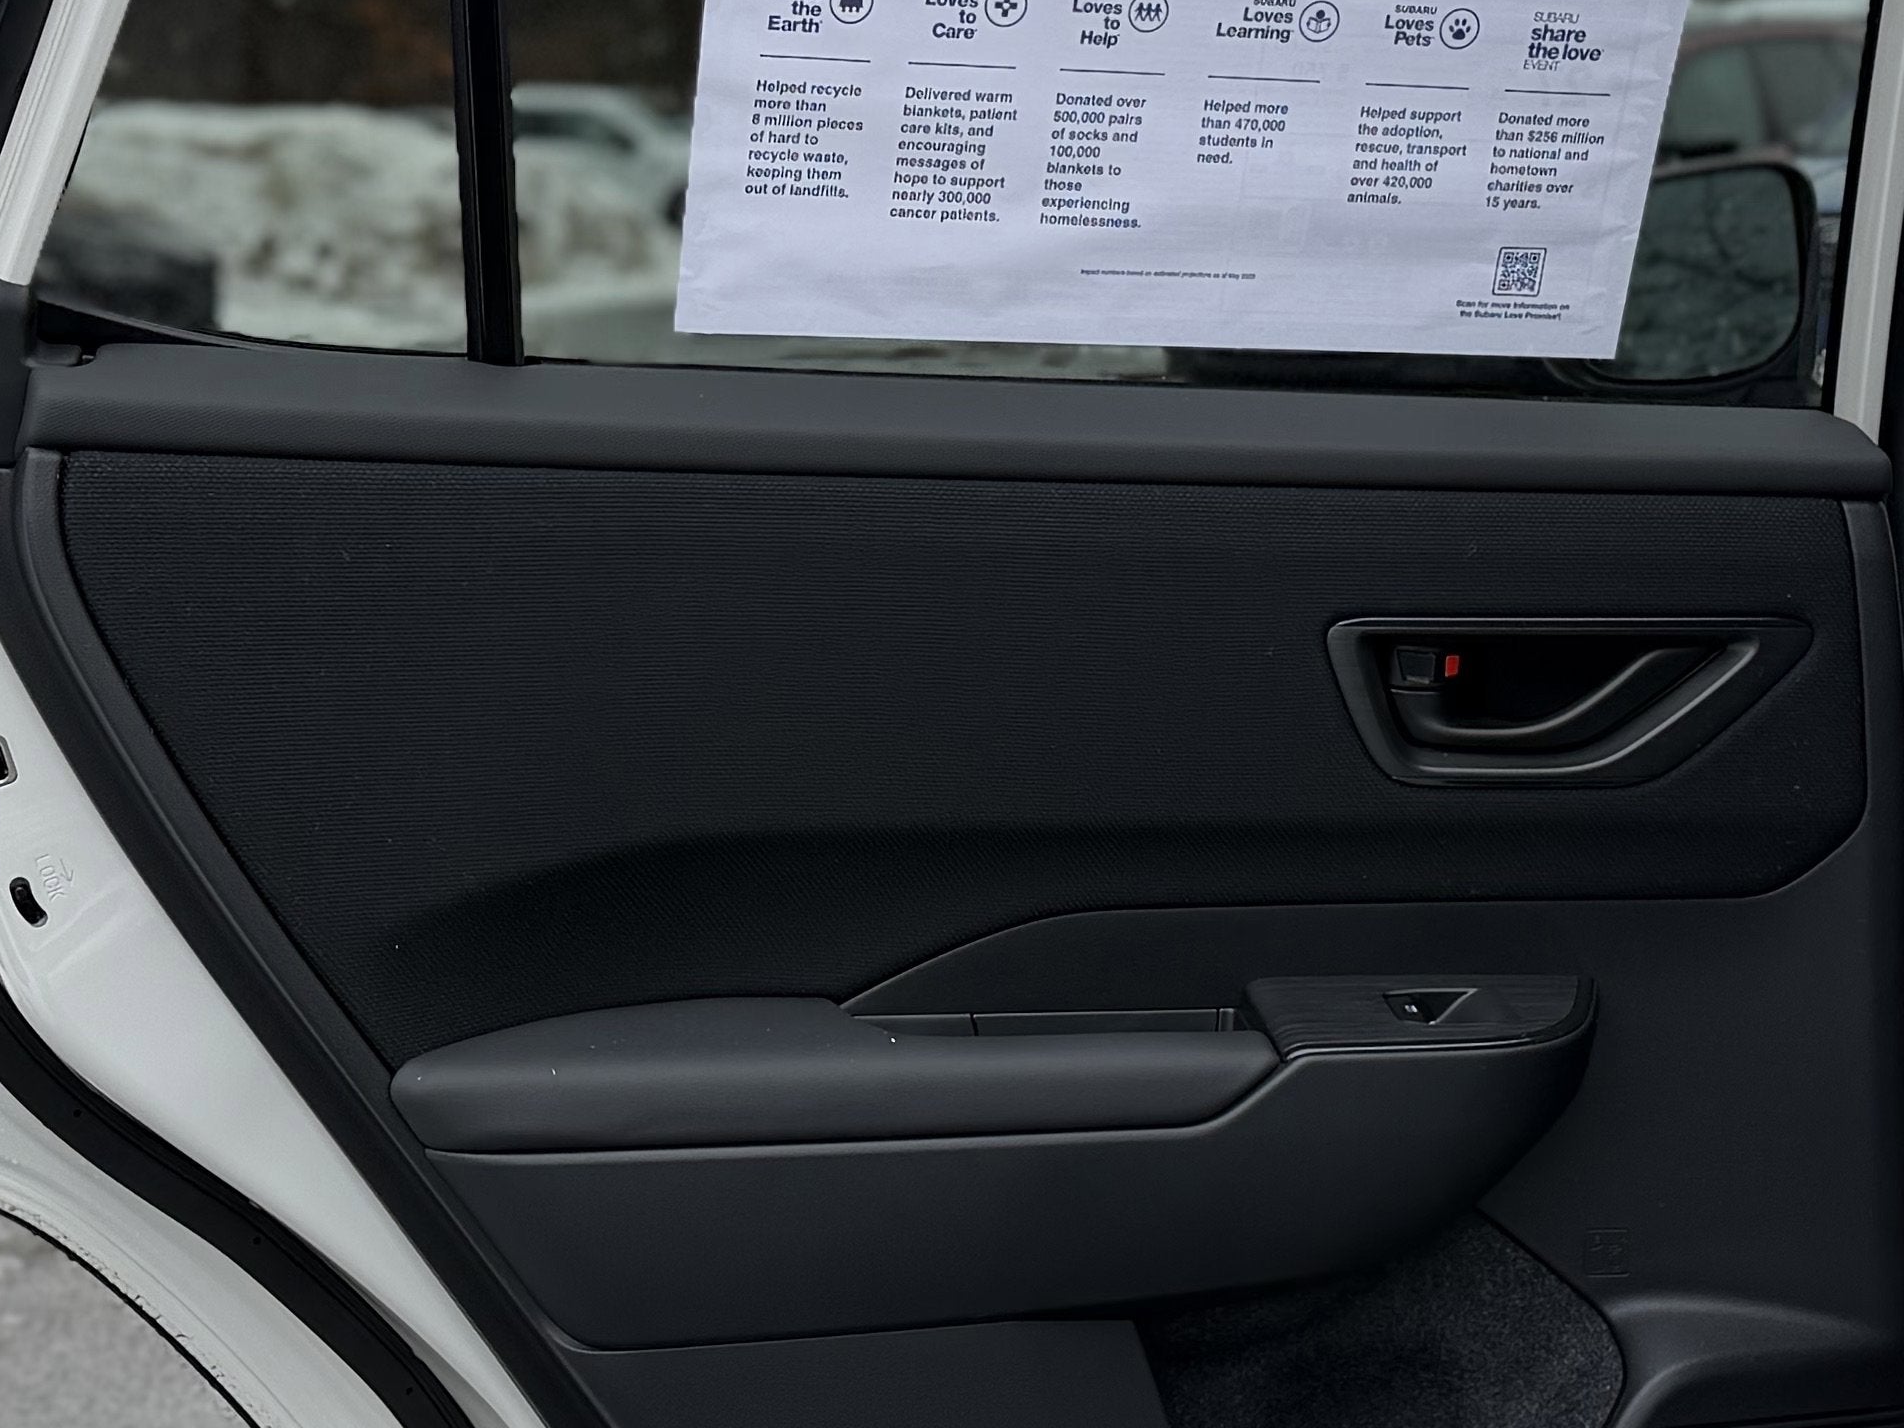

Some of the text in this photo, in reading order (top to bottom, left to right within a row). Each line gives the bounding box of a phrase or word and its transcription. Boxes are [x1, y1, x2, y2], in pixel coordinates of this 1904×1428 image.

[791, 0, 821, 17] the
[958, 9, 977, 25] to
[1242, 6, 1294, 24] Loves
[1394, 4, 1438, 16] SUBARU
[767, 15, 819, 34] Earth
[1103, 15, 1121, 31] to
[1384, 14, 1435, 32] Loves
[1533, 11, 1580, 25] SUBARU
[932, 22, 978, 40] Care
[1079, 29, 1121, 49] Help
[1215, 22, 1292, 44] Learning
[1393, 30, 1435, 47] Pets
[1530, 23, 1587, 44] share
[1528, 41, 1602, 62] the love
[1522, 58, 1561, 72] EVENT
[756, 79, 862, 99] Helped recycle
[905, 86, 1013, 104] Delivered warm
[753, 98, 827, 112] more than
[1055, 92, 1147, 109] Donated over
[1203, 99, 1289, 116] Helped more
[902, 103, 1018, 122] blankets, patient
[1053, 110, 1143, 127] 500,000 pairs
[1360, 105, 1462, 125] Helped support
[1498, 111, 1590, 128] Donated more
[751, 113, 864, 132] 8 million pieces
[900, 121, 994, 139] care kits, and
[1201, 116, 1286, 133] than 470,000
[749, 129, 819, 146] of hard to
[1051, 127, 1139, 143] of socks and
[1358, 122, 1443, 141] the adoption,
[1495, 128, 1605, 145] than $256 million
[897, 140, 986, 157] encouraging
[1198, 134, 1274, 149] students in
[1355, 142, 1467, 158] rescue, transport
[748, 148, 848, 166] recycle waste,
[1049, 144, 1101, 161] 100,000
[1196, 151, 1233, 164] need.
[1492, 146, 1590, 161] to national and
[895, 156, 986, 172] messages of
[1046, 161, 1122, 176] blankets to
[1352, 157, 1439, 172] and health of
[1489, 161, 1558, 177] hometown
[746, 164, 842, 183] keeping them
[893, 170, 1005, 190] hope to support
[744, 183, 849, 199] out of landfills.
[1044, 178, 1083, 192] those
[1350, 175, 1433, 190] over 420,000
[1487, 178, 1574, 194] charities over
[891, 189, 992, 206] nearly 300,000
[1041, 196, 1130, 215] experiencing
[1346, 190, 1402, 205] animals.
[1485, 195, 1541, 212] 15 years.
[889, 207, 1000, 223] cancer patients.
[1039, 212, 1141, 229] homelessness.
[36, 854, 64, 901] LOCK
